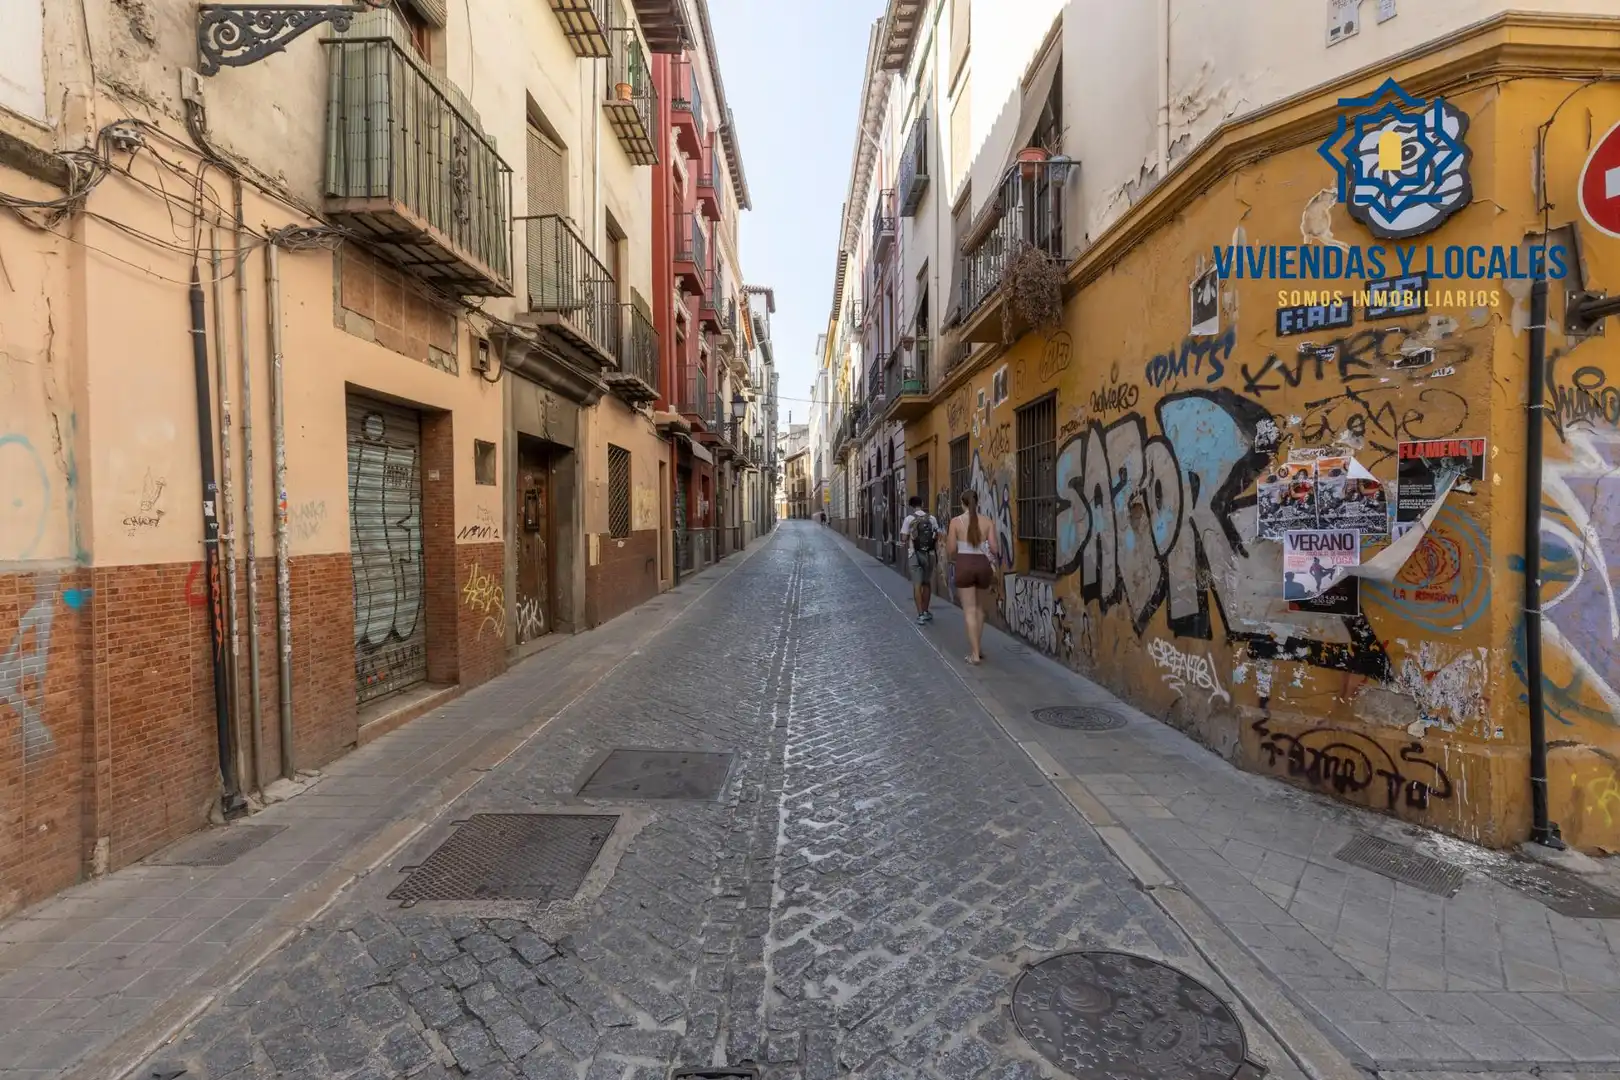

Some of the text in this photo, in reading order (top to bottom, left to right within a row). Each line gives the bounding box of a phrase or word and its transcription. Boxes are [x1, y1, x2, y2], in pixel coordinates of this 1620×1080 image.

[1399, 439, 1484, 459] FLAMENCO
[1288, 533, 1354, 551] VERANO
[1330, 556, 1353, 565] YOGA
